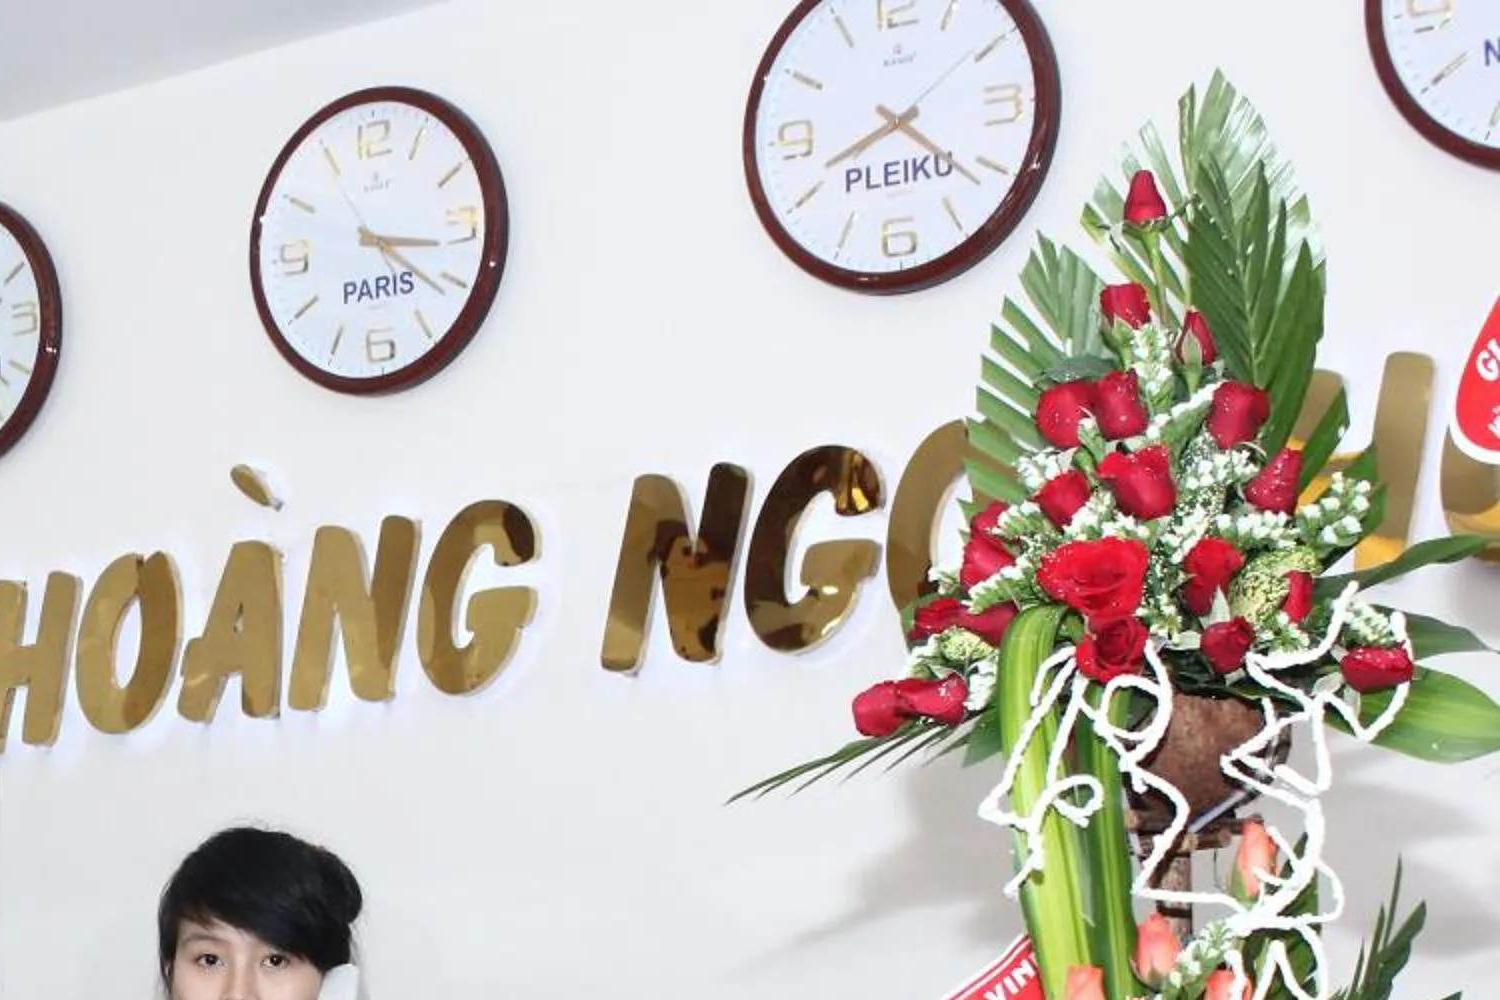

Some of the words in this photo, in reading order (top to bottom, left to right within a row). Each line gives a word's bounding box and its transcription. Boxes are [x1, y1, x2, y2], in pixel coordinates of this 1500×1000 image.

[983, 82, 1025, 127] 3
[357, 120, 393, 160] 12
[777, 119, 814, 161] 9
[844, 151, 955, 193] PLEIKU
[446, 205, 478, 246] 3
[881, 217, 918, 258] 6
[280, 239, 310, 277] 9
[342, 270, 416, 305] PARIS
[12, 300, 40, 336] 3
[365, 327, 397, 363] 6
